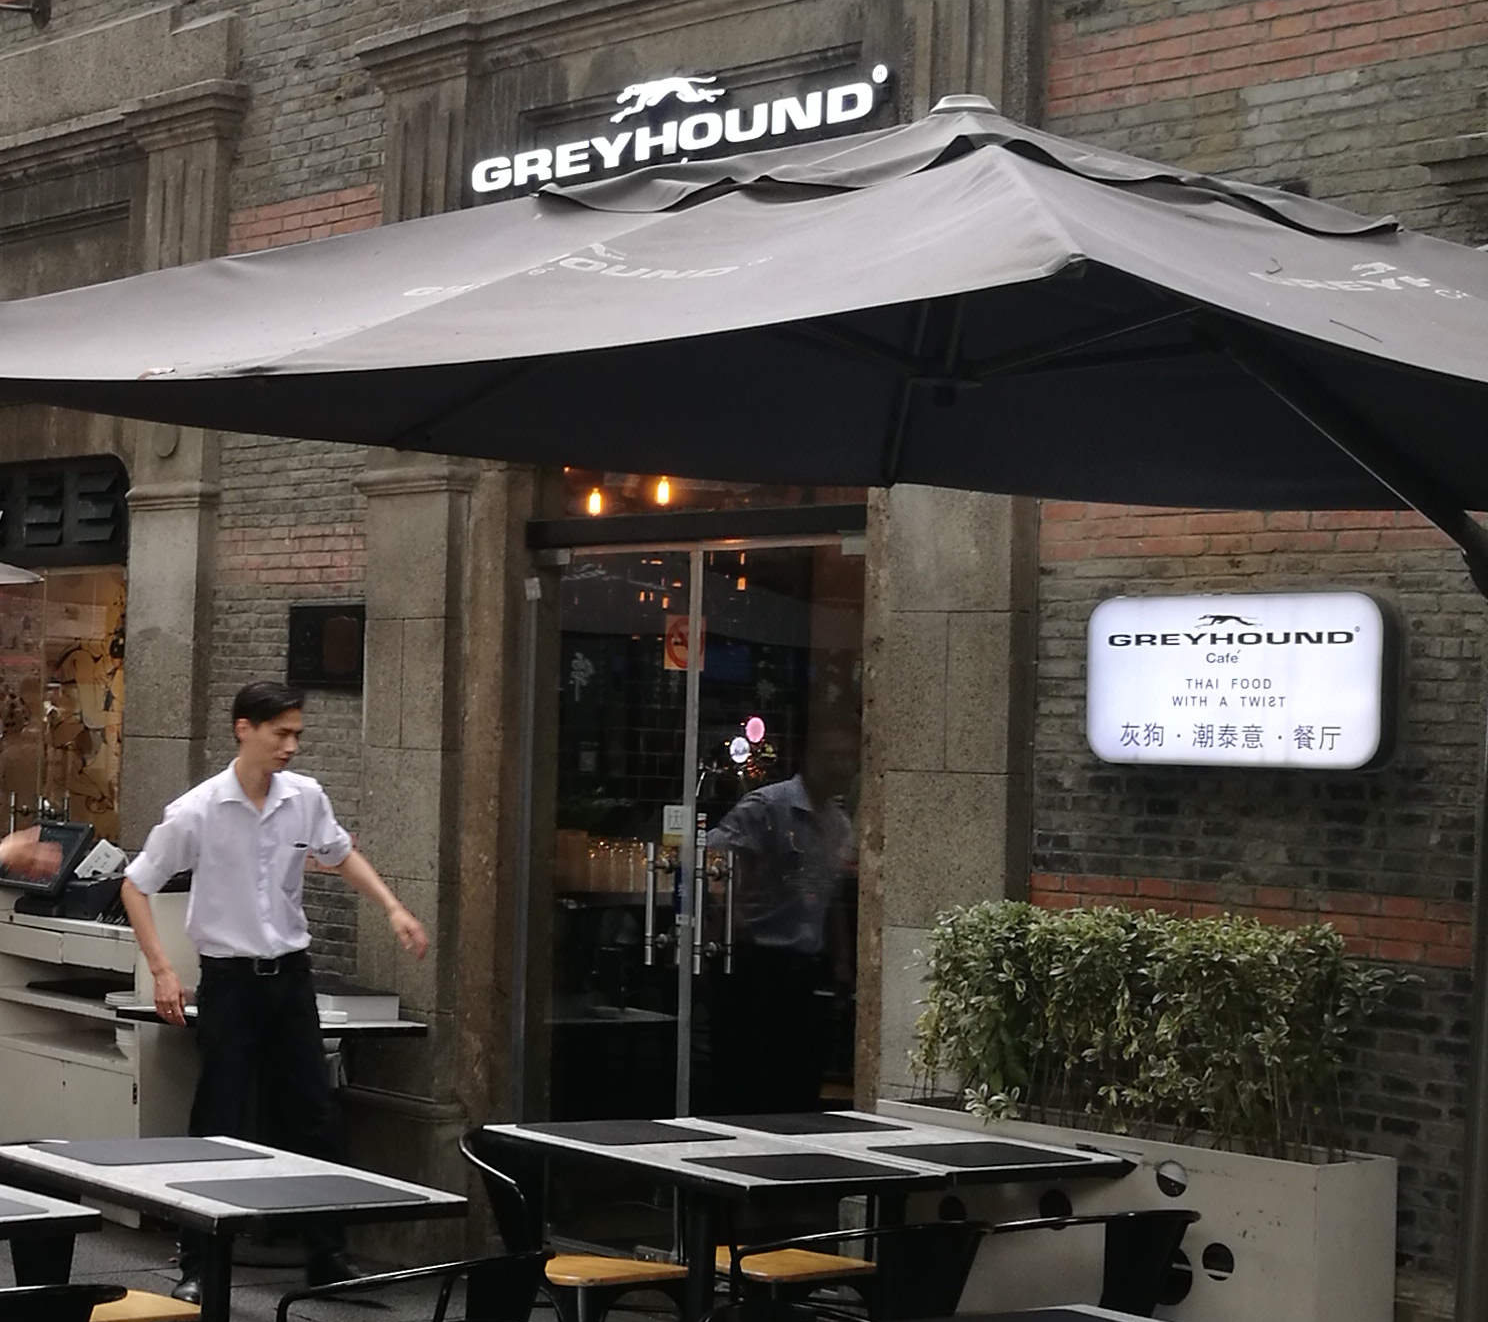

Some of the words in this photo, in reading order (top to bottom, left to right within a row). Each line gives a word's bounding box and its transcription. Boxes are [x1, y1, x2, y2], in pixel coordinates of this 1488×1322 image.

[471, 80, 875, 194] GREYHOUND
[1108, 631, 1354, 647] GREYHOUND
[1186, 678, 1219, 690] THAI
[1231, 678, 1272, 690] FOOD
[1172, 696, 1208, 707] WITH
[1219, 696, 1228, 707] A
[1240, 696, 1286, 707] TWIST
